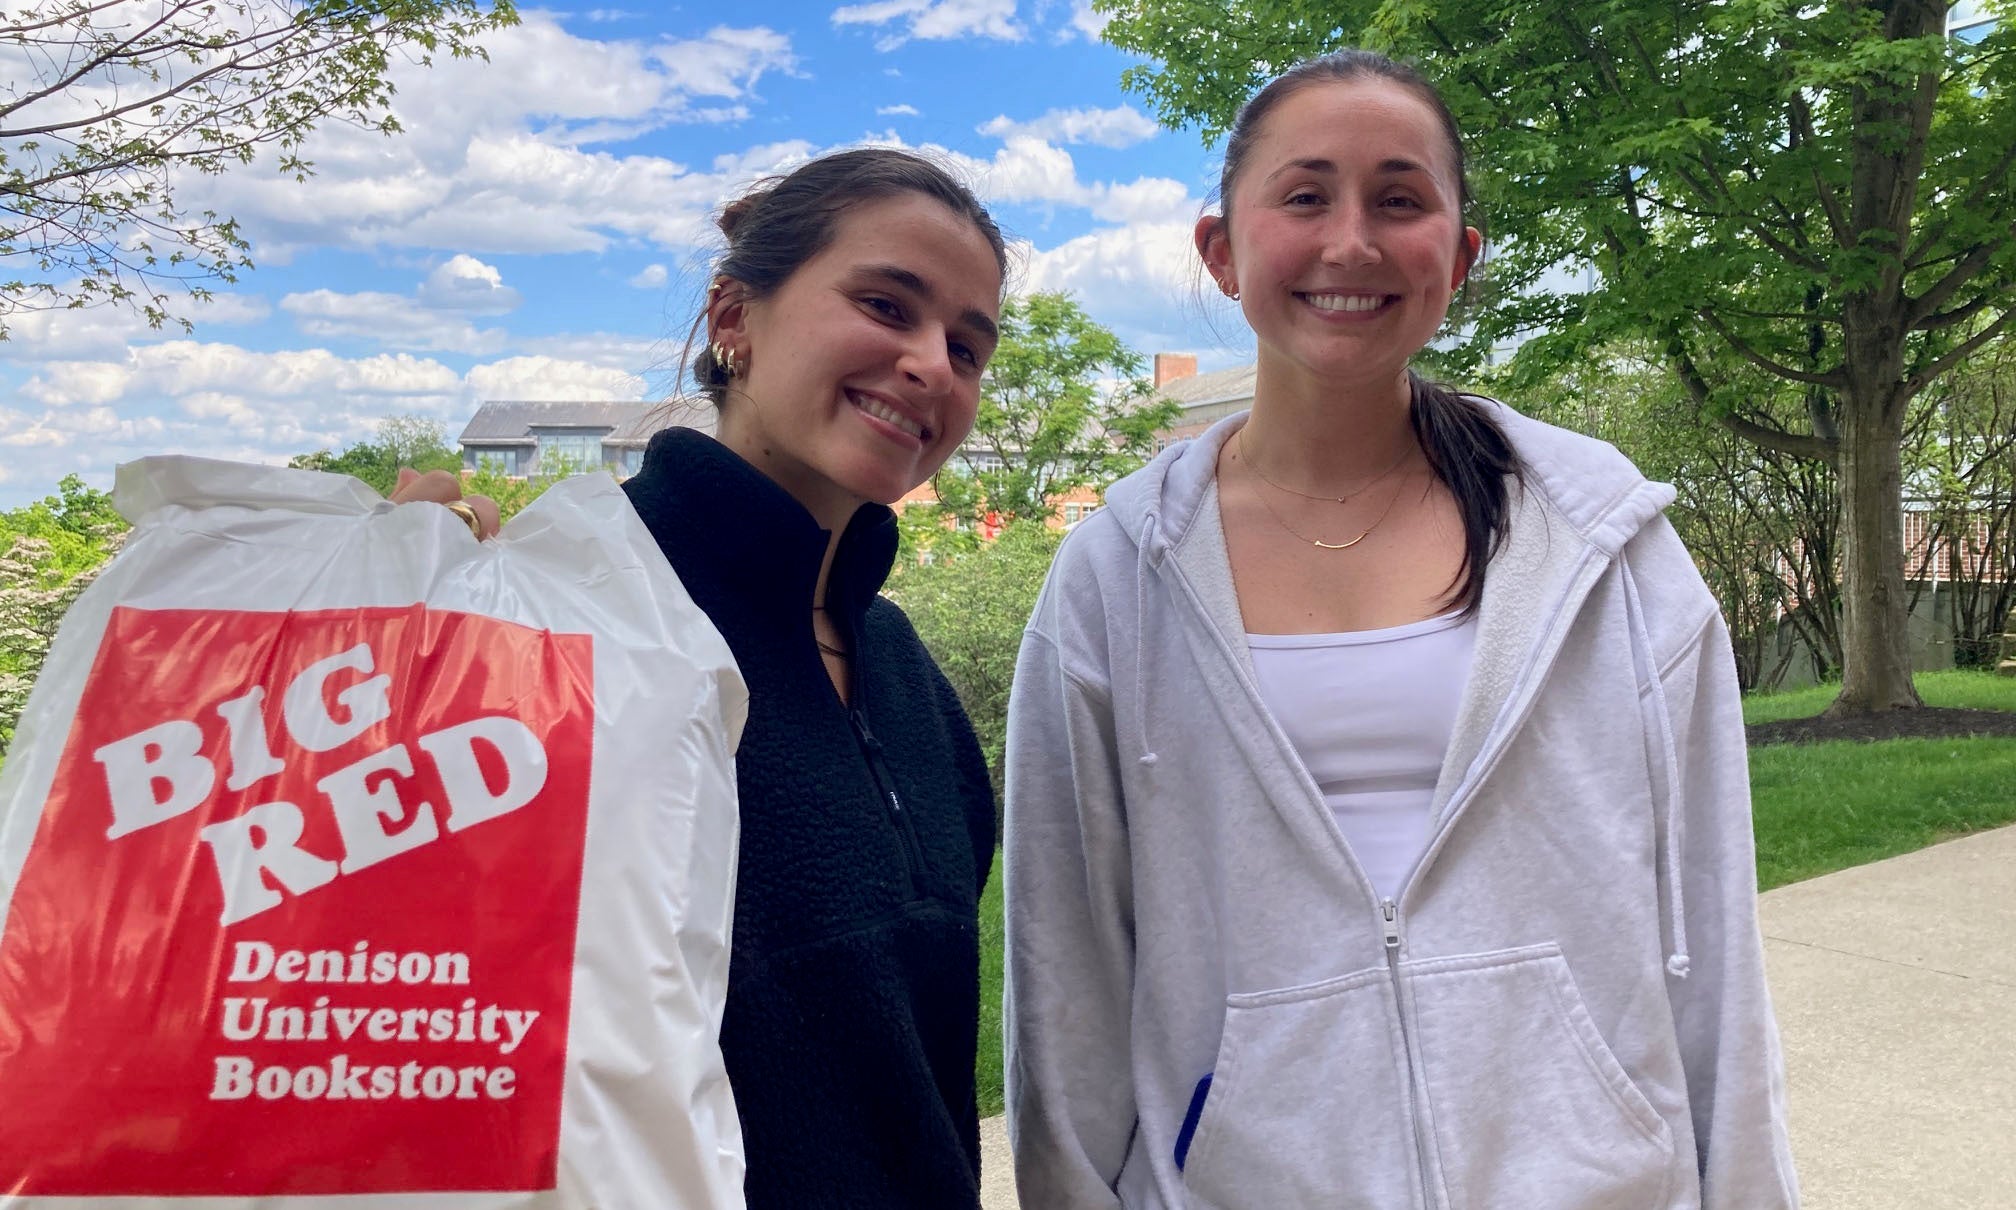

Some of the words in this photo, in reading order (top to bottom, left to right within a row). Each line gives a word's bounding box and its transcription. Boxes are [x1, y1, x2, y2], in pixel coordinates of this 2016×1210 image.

[94, 642, 392, 841] BIG
[200, 716, 548, 928] RED
[228, 941, 470, 985] Denison
[222, 996, 540, 1054] University
[210, 1055, 516, 1100] Bookstore
